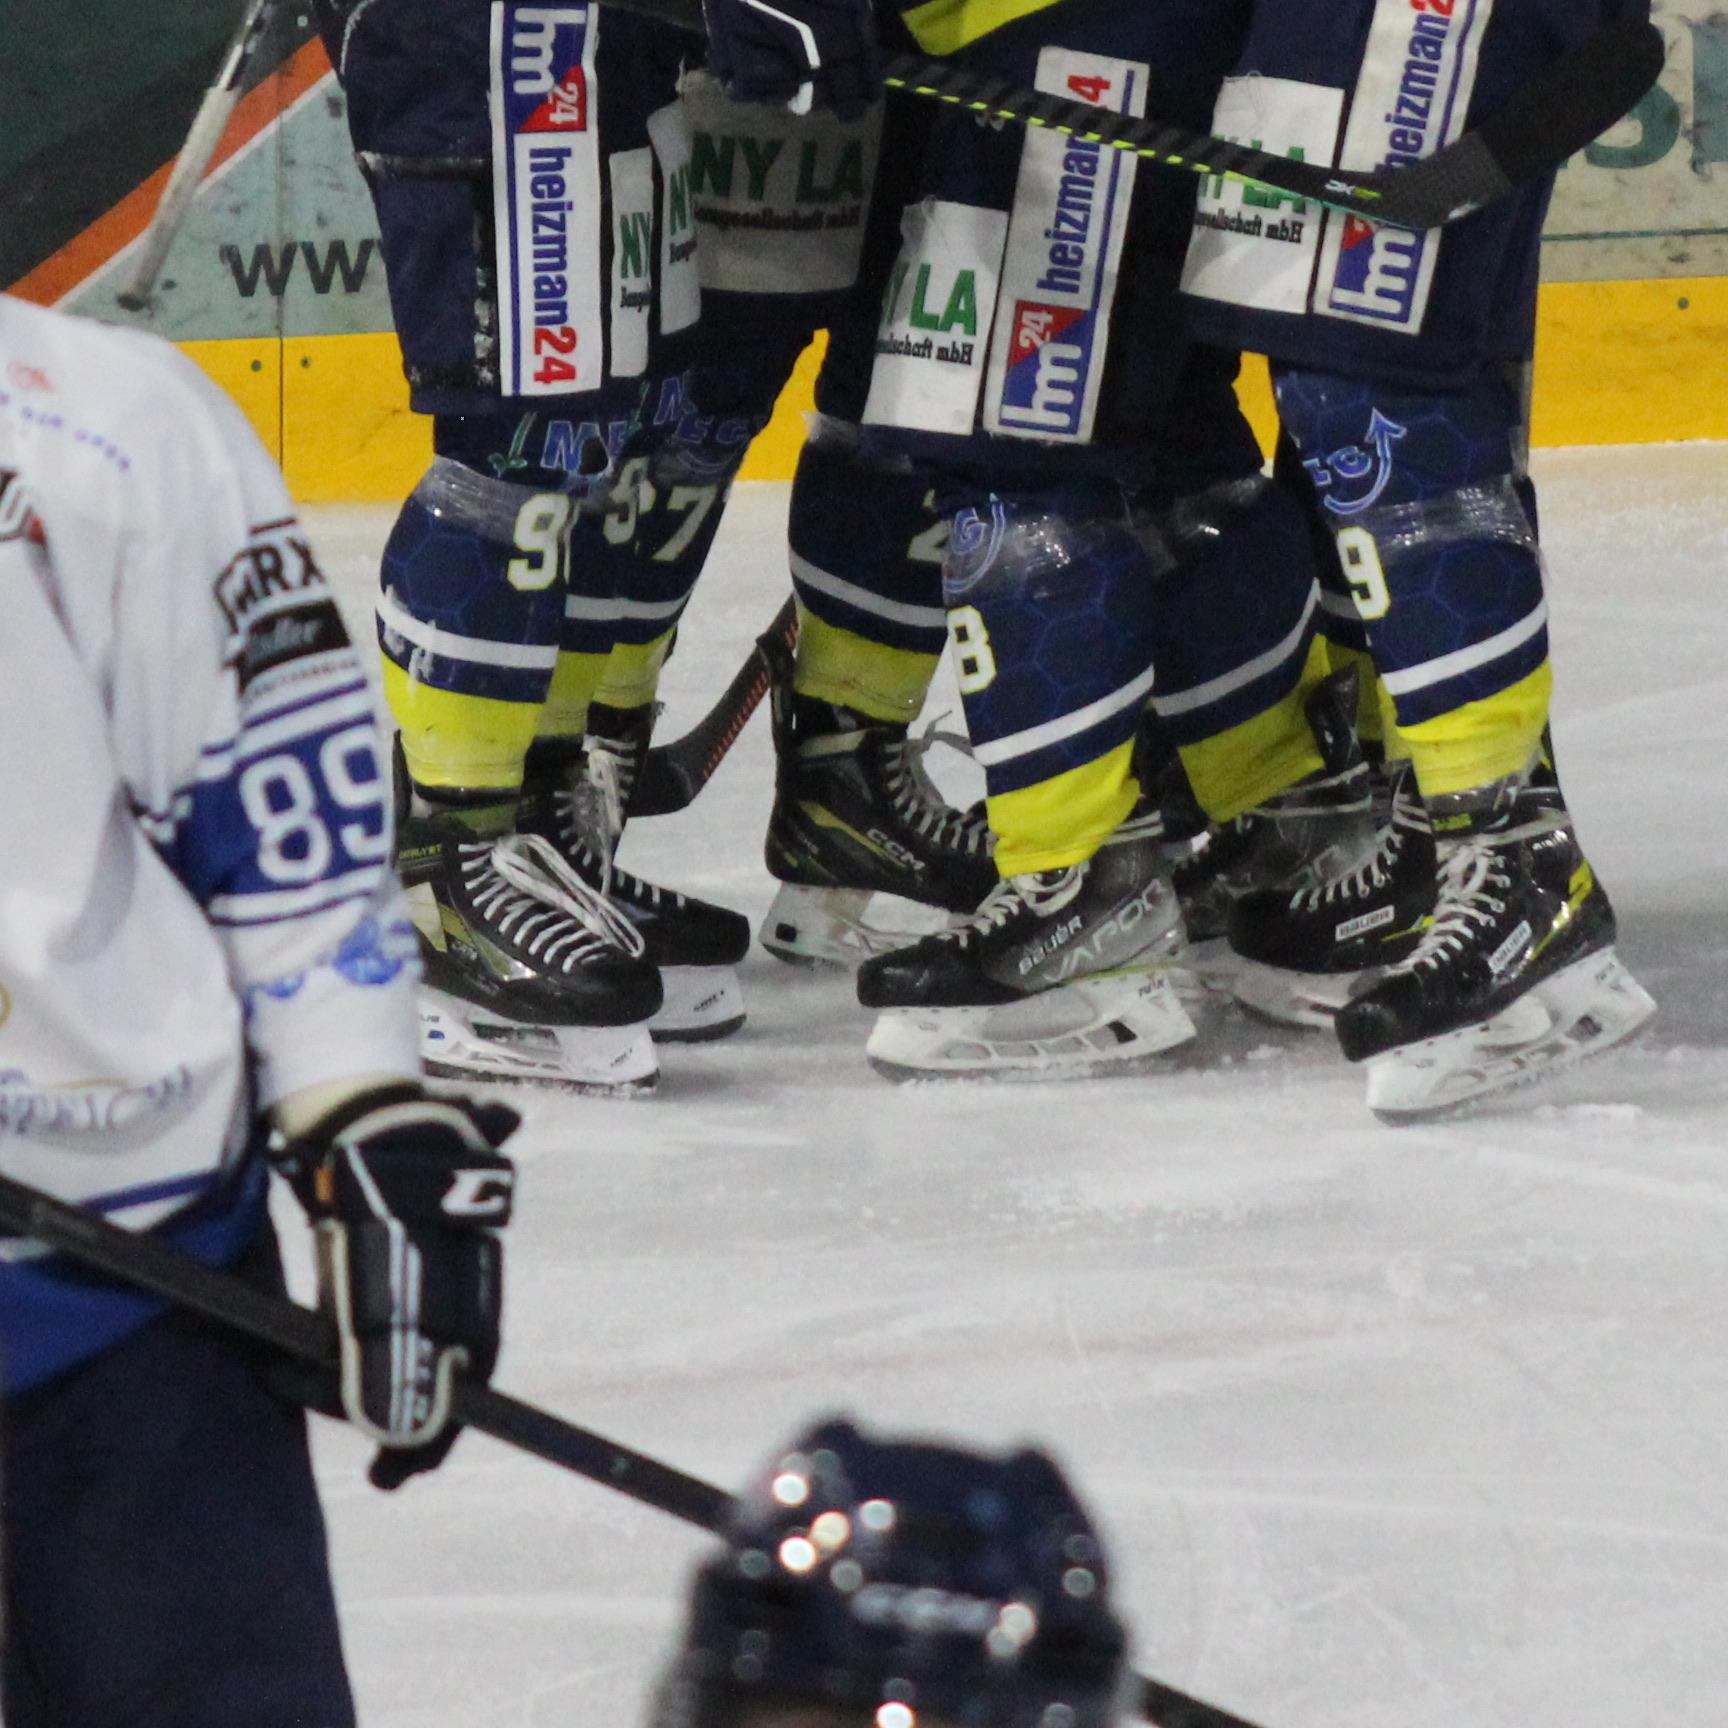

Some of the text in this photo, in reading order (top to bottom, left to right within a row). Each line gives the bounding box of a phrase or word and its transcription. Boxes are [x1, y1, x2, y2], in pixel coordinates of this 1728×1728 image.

[219, 238, 385, 298] ww
[527, 146, 578, 386] heizman24
[239, 724, 396, 884] 89
